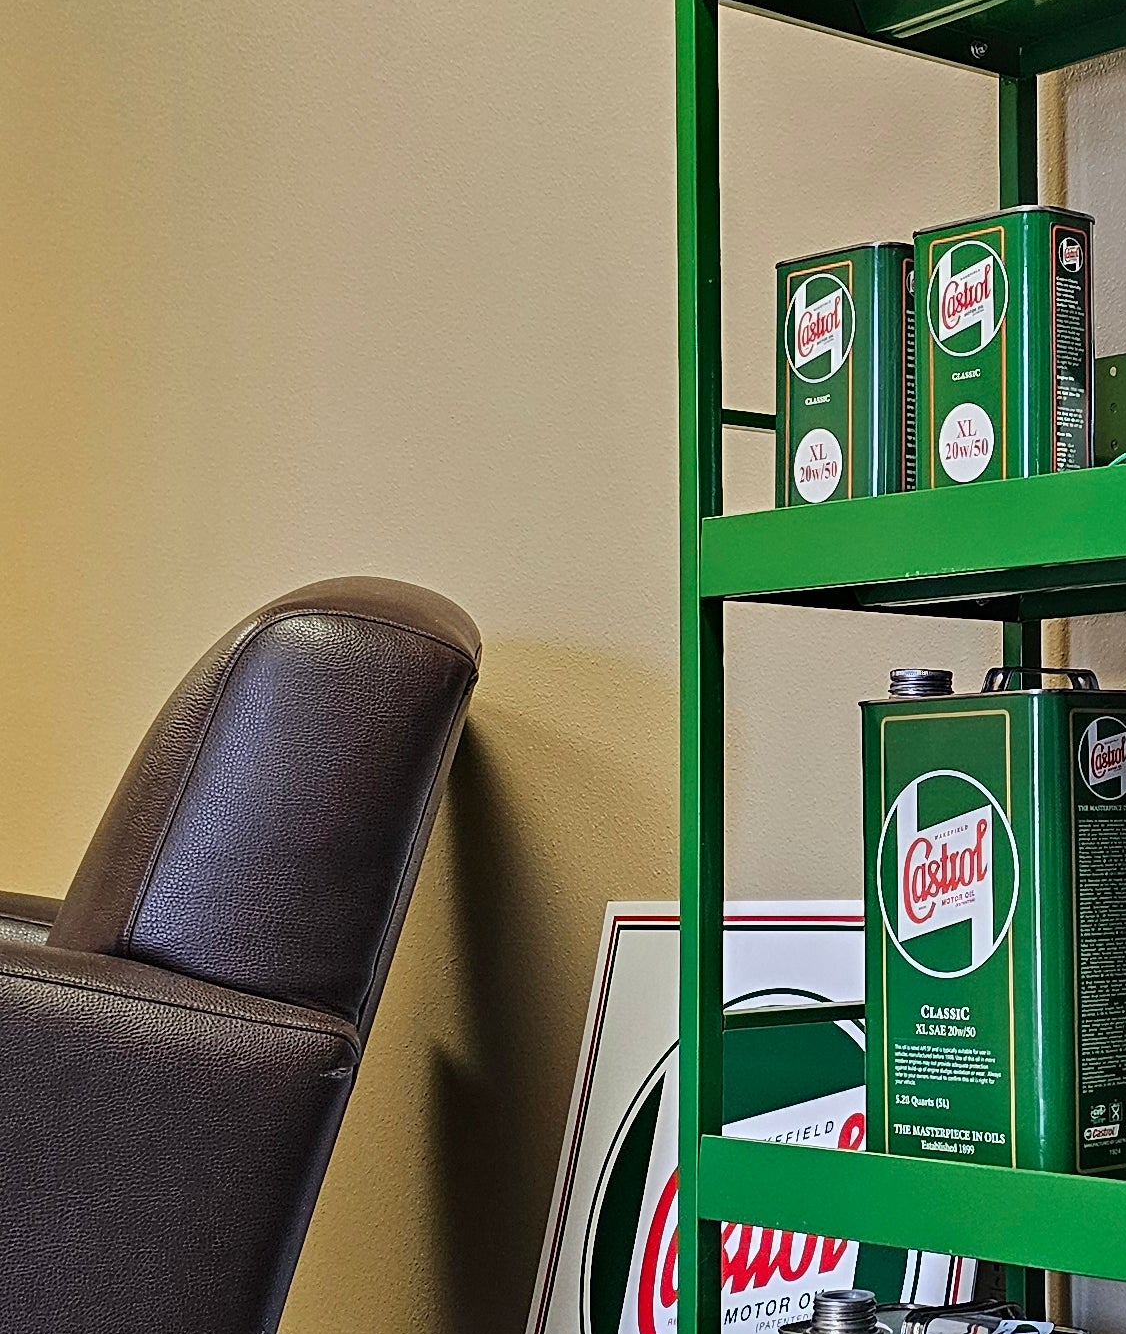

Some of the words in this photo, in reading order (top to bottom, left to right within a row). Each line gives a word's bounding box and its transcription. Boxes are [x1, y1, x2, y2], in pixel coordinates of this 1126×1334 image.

[942, 264, 991, 330] Castrol
[798, 295, 841, 358] Castrol
[957, 419, 977, 439] XL
[809, 443, 827, 462] XL
[945, 438, 989, 460] 20w/50
[800, 461, 838, 484] 20w/50
[1091, 736, 1126, 779] Castrol
[903, 818, 988, 924] Castrol
[915, 1024, 929, 1035] XL
[929, 1025, 947, 1037] SAE
[947, 1025, 976, 1038] 20w/50
[911, 1095, 934, 1107] Quarts
[893, 1124, 912, 1135] THE
[912, 1125, 971, 1140] MASTERPIECE
[972, 1130, 983, 1142] IN
[984, 1131, 1006, 1144] OILS
[921, 1140, 958, 1153] Established
[724, 1296, 790, 1325] MOTOR
